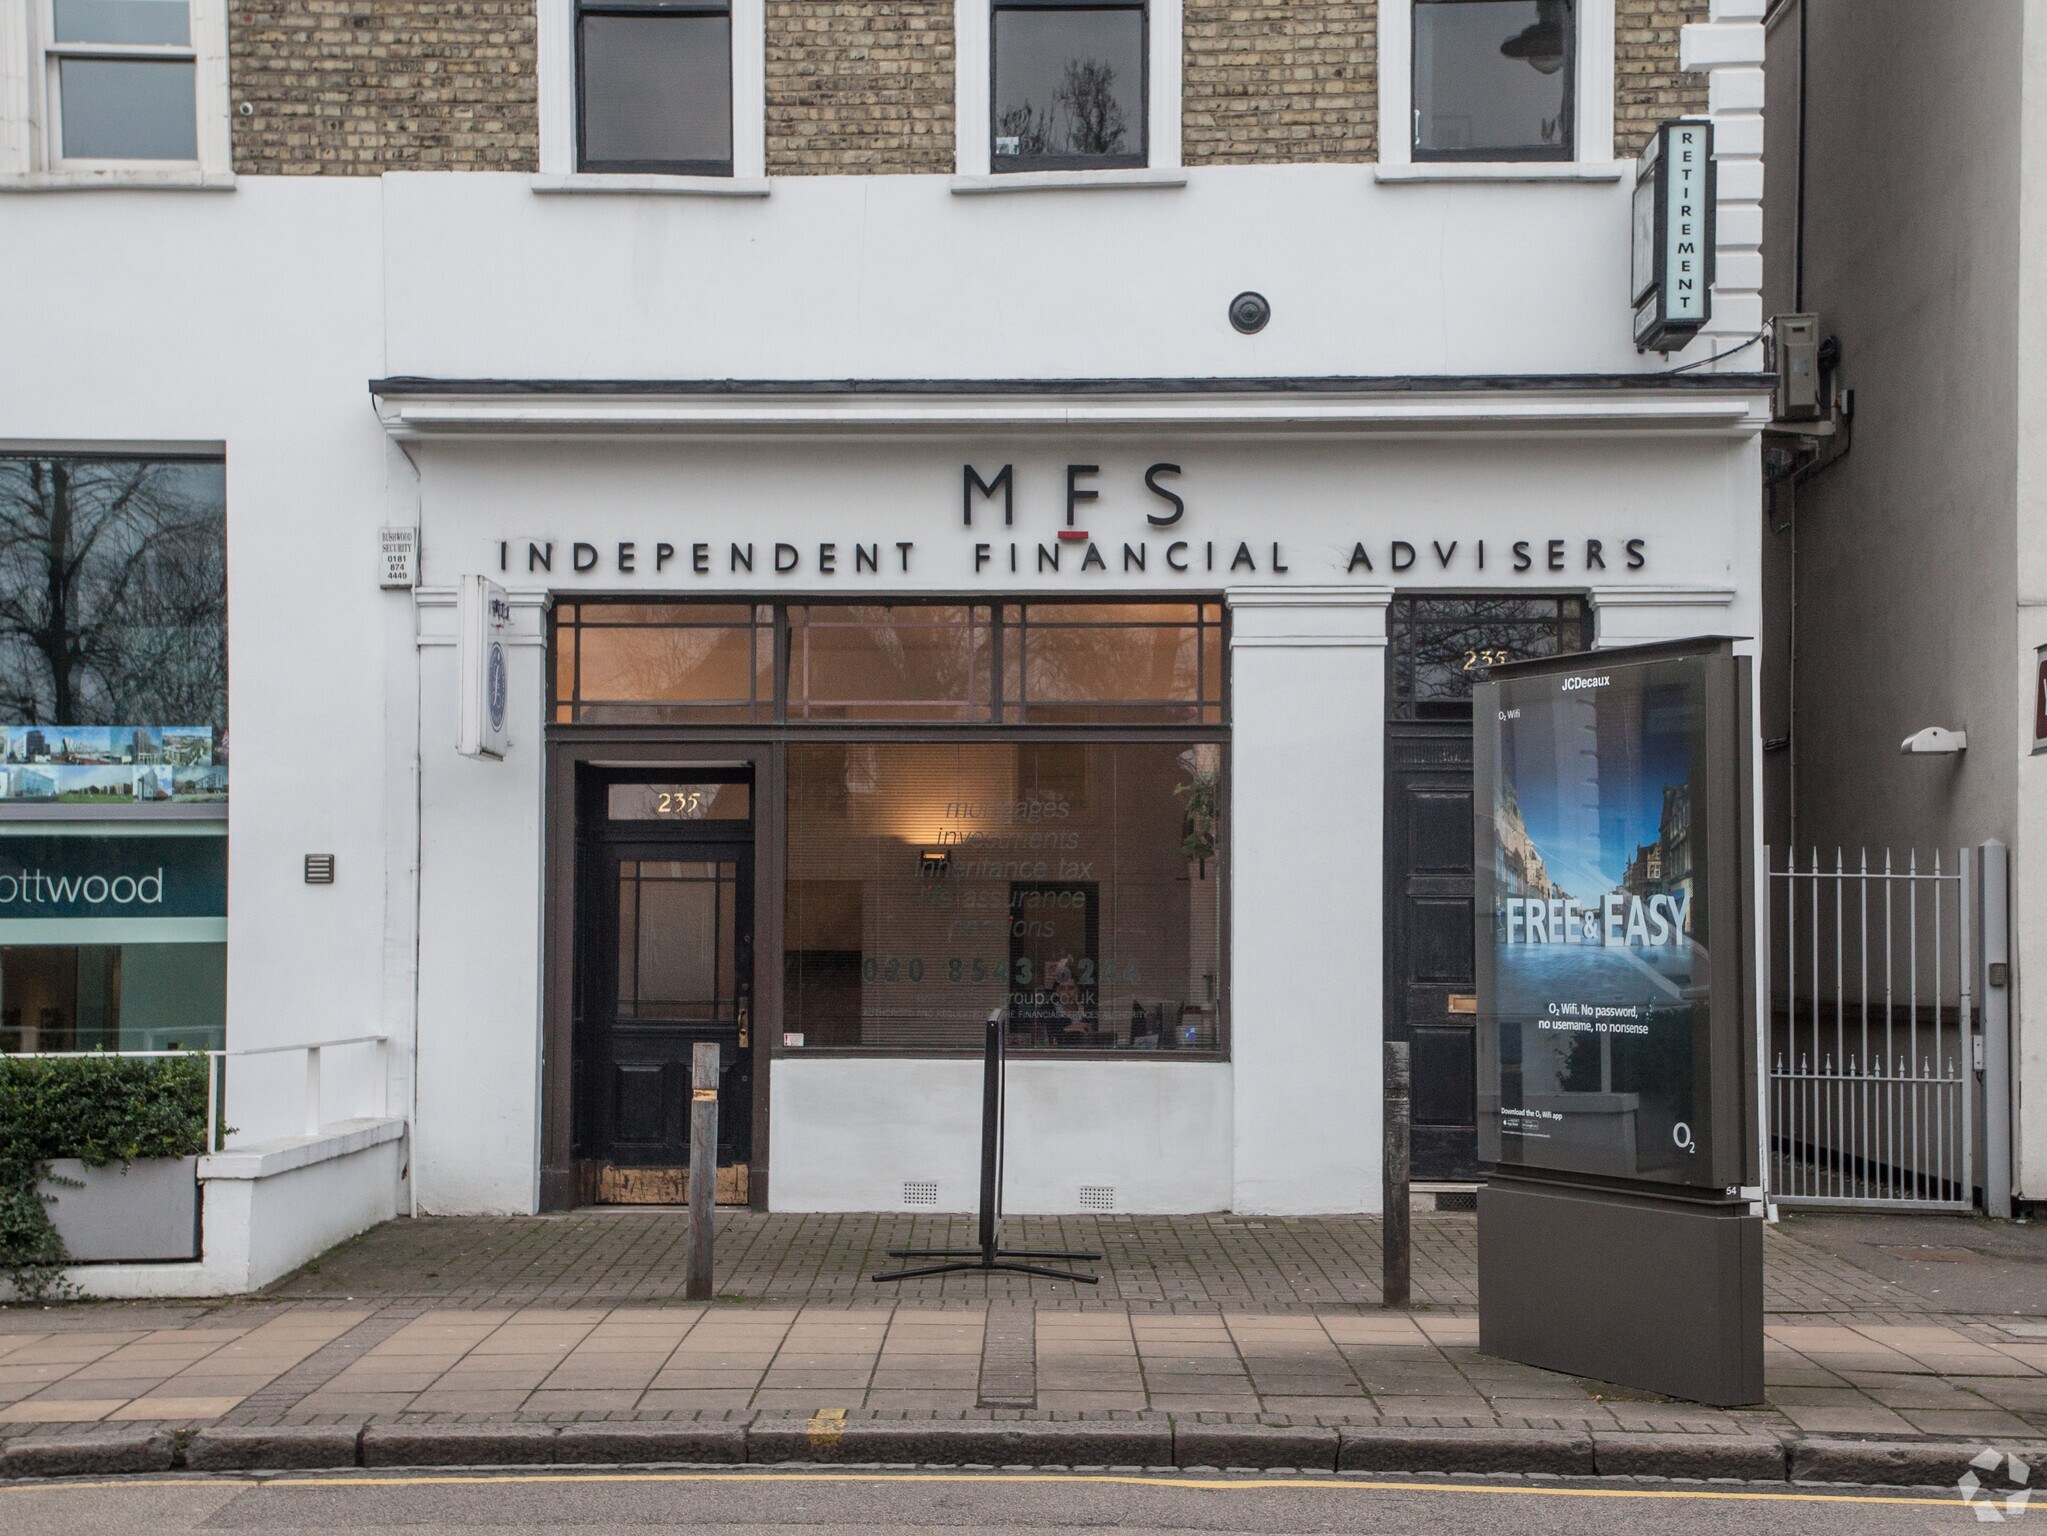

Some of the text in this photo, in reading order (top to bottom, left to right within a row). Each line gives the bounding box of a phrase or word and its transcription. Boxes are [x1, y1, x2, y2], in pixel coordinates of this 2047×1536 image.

[1678, 132, 1695, 309] RETIREMENT
[963, 462, 1186, 527] MFS
[382, 543, 412, 553] SECURITY
[501, 539, 1646, 574] INDEPENDENT FINANCIAL ADVISERS
[387, 572, 408, 580] 4449
[1561, 675, 1610, 692] JCDecaux
[1507, 709, 1521, 720] Wifi
[658, 792, 701, 813] 235
[936, 827, 1080, 850] investments
[914, 856, 1093, 880] inheritance tax
[962, 888, 1086, 910] assurance
[1506, 894, 1691, 947] FREE & EASY
[862, 956, 924, 983] 020
[948, 957, 1033, 985] 8543
[1561, 1003, 1580, 1015] Wifi.
[1581, 1003, 1594, 1016] No
[1595, 1005, 1638, 1019] password,
[1538, 1020, 1649, 1035] no username, no nonsense
[1501, 1107, 1525, 1116] Download
[1526, 1108, 1535, 1117] the
[1542, 1110, 1552, 1119] Wifi
[1552, 1113, 1563, 1121] app
